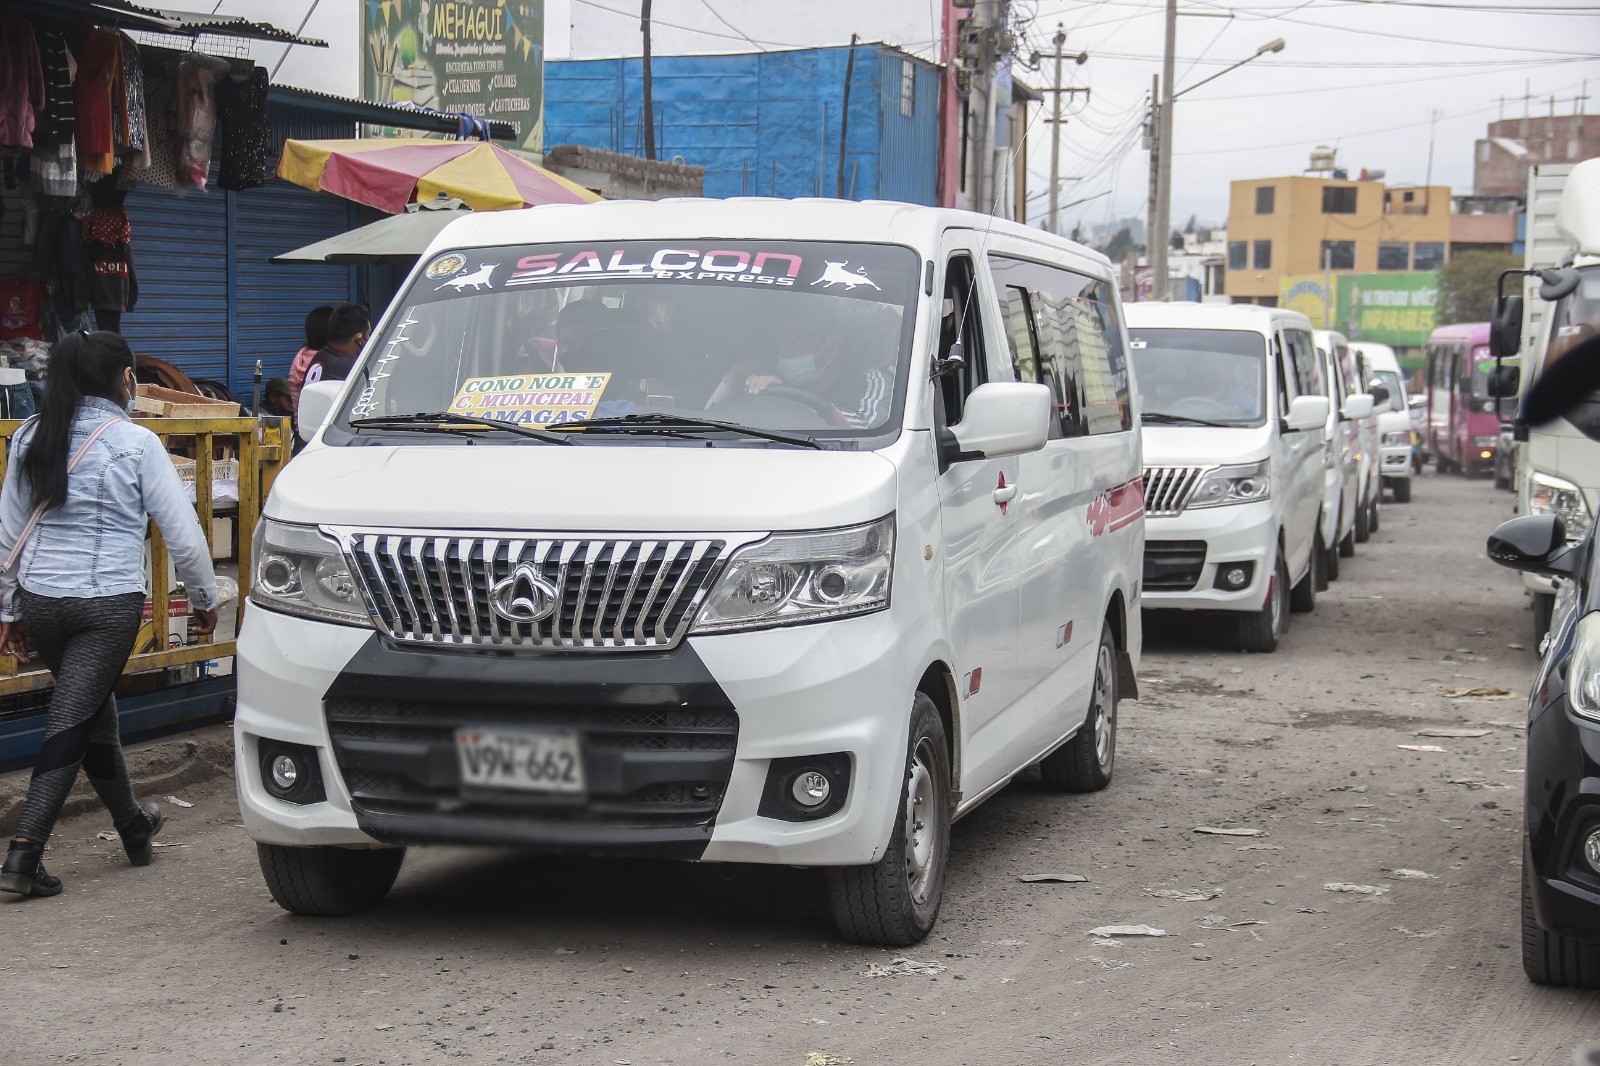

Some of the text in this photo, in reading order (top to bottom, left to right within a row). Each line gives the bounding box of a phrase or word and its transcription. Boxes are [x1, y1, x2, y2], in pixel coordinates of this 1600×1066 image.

[445, 61, 473, 72] ENCUENTRA
[473, 60, 486, 71] TODO
[486, 60, 496, 71] TIPO
[448, 79, 481, 93] CUADERNOS
[493, 74, 517, 88] COLORES
[494, 97, 530, 112] CARTUCHERAS
[464, 375, 605, 393] CONO NORE
[455, 392, 595, 409] C. MUNICIPAL
[454, 409, 588, 424] AMAGAS
